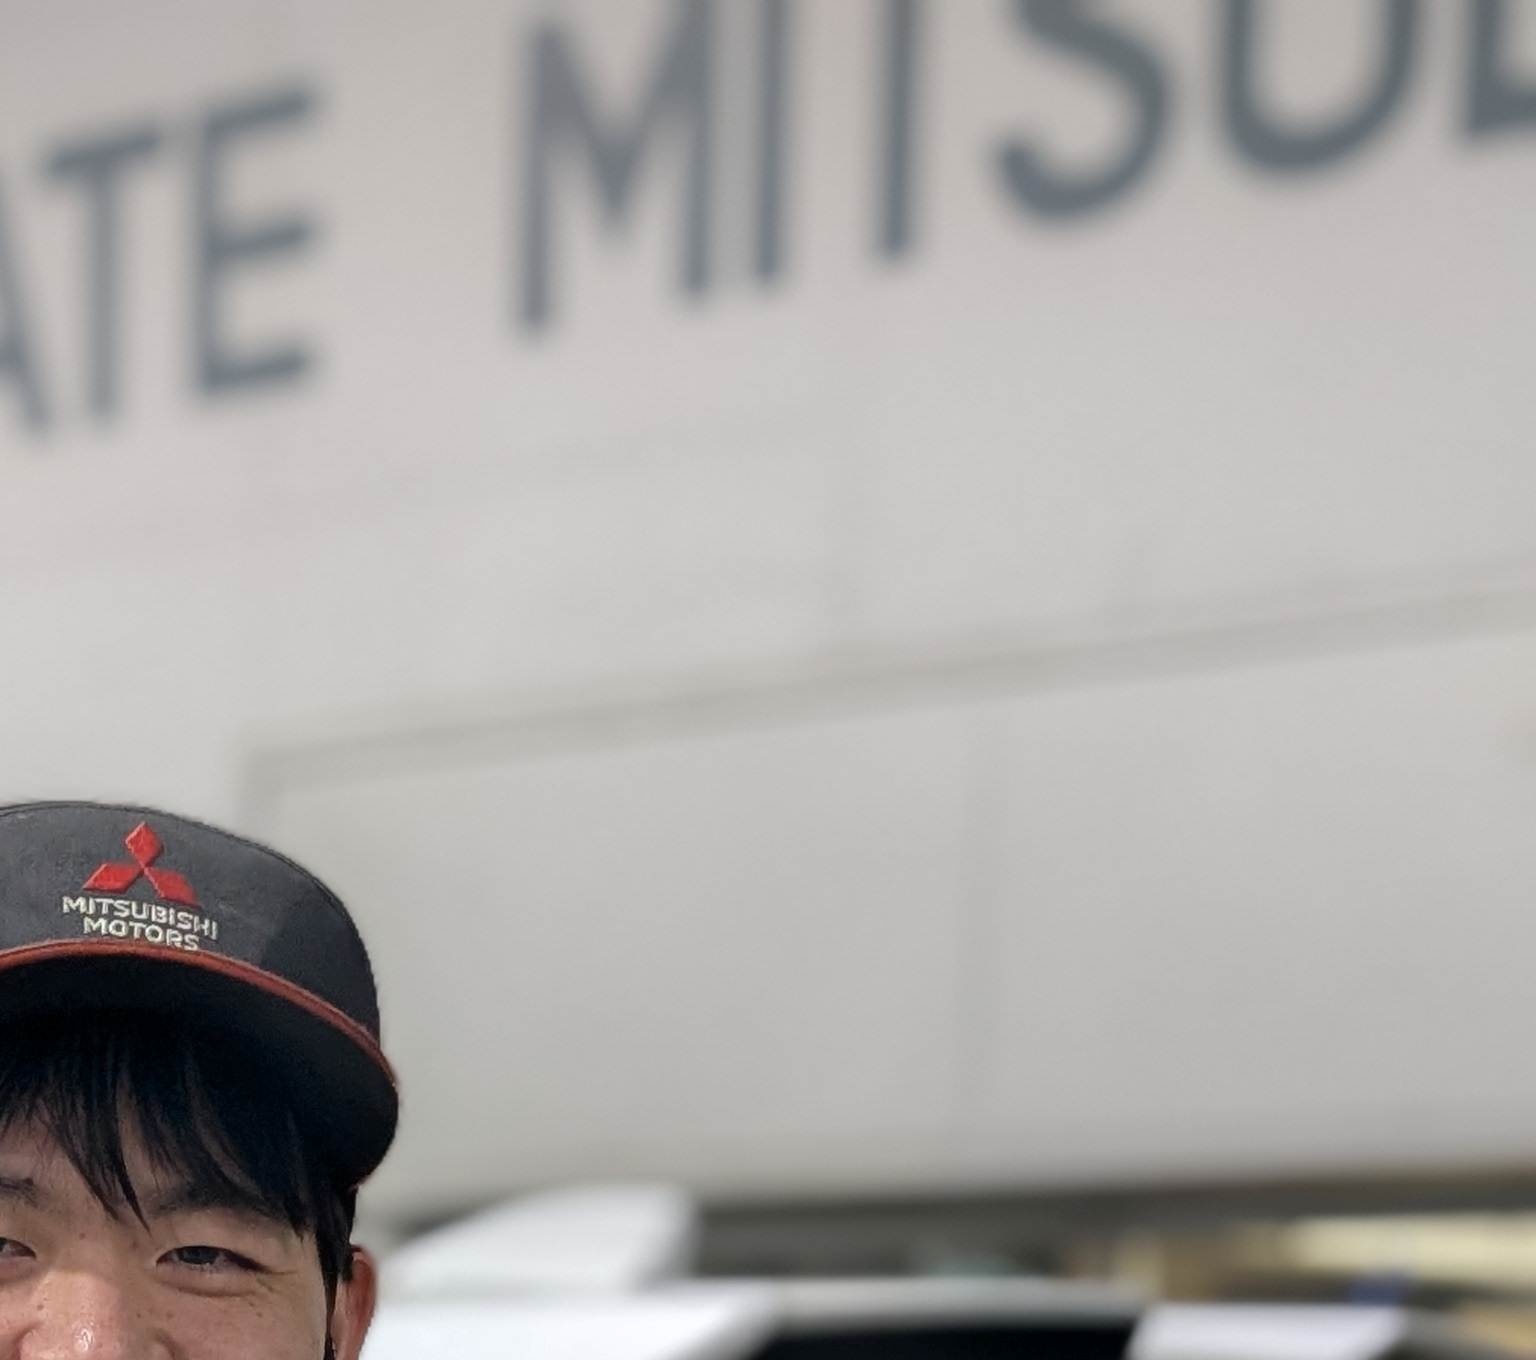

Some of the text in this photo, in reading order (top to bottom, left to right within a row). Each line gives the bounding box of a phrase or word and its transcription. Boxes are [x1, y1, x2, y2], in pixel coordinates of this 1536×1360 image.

[512, 0, 1536, 340] MITSU
[61, 895, 218, 941] MITSUBISHI
[82, 916, 201, 951] MOTORS
